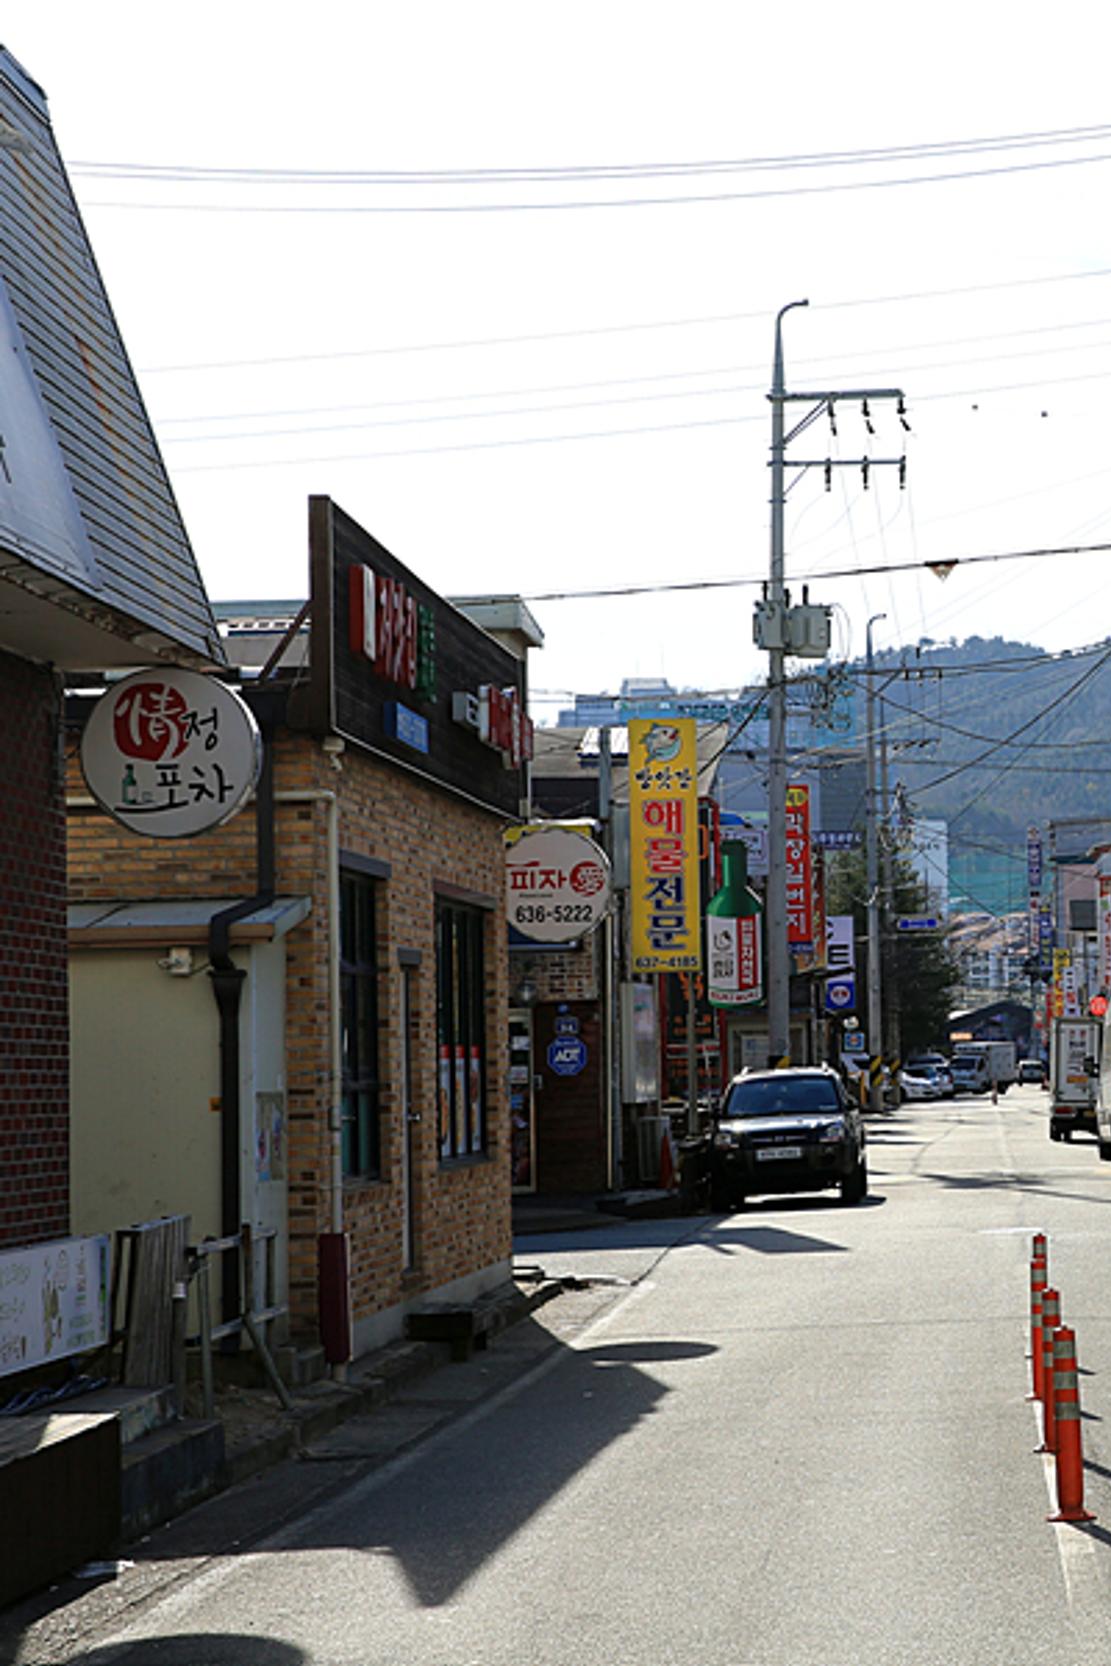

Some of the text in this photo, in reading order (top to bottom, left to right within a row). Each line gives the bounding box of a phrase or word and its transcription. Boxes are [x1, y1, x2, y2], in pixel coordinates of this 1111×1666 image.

[180, 707, 219, 751] 정
[152, 763, 235, 810] 포차
[509, 867, 568, 891] 피자
[515, 904, 593, 925] 636-5222
